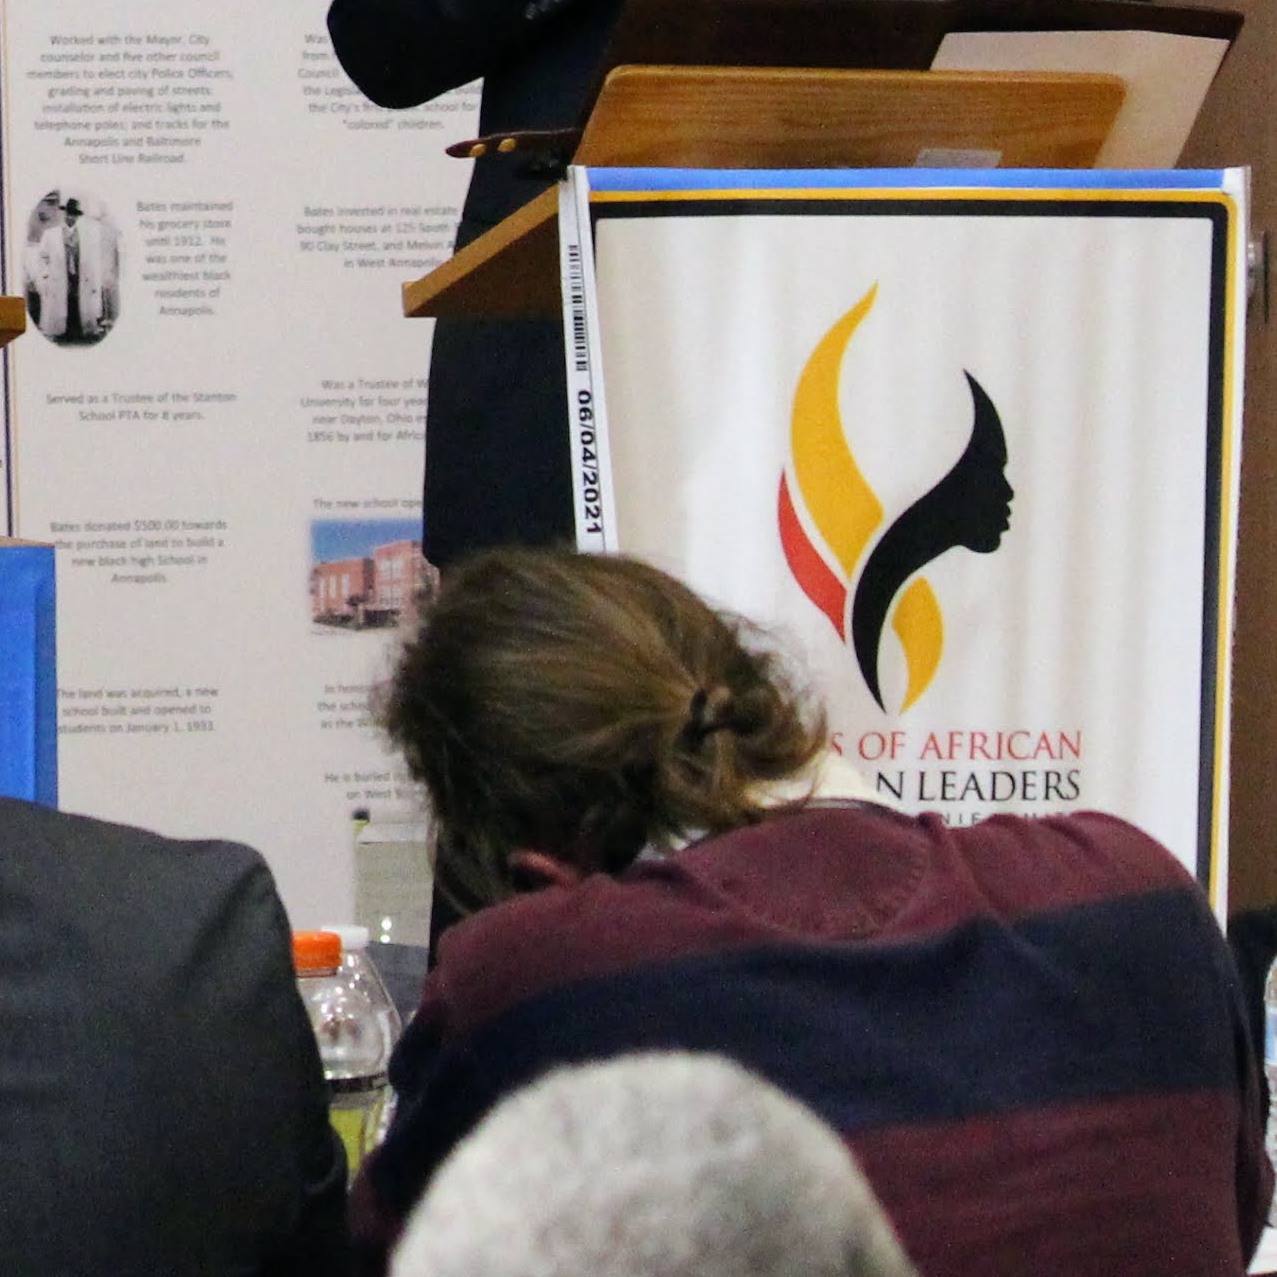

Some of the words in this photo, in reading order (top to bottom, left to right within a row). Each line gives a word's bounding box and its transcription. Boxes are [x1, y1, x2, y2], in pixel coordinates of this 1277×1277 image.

[576, 388, 604, 535] 06/04/2021
[858, 731, 906, 761] OF
[919, 730, 1082, 761] AFRICAN
[919, 770, 1082, 802] LEADERS
